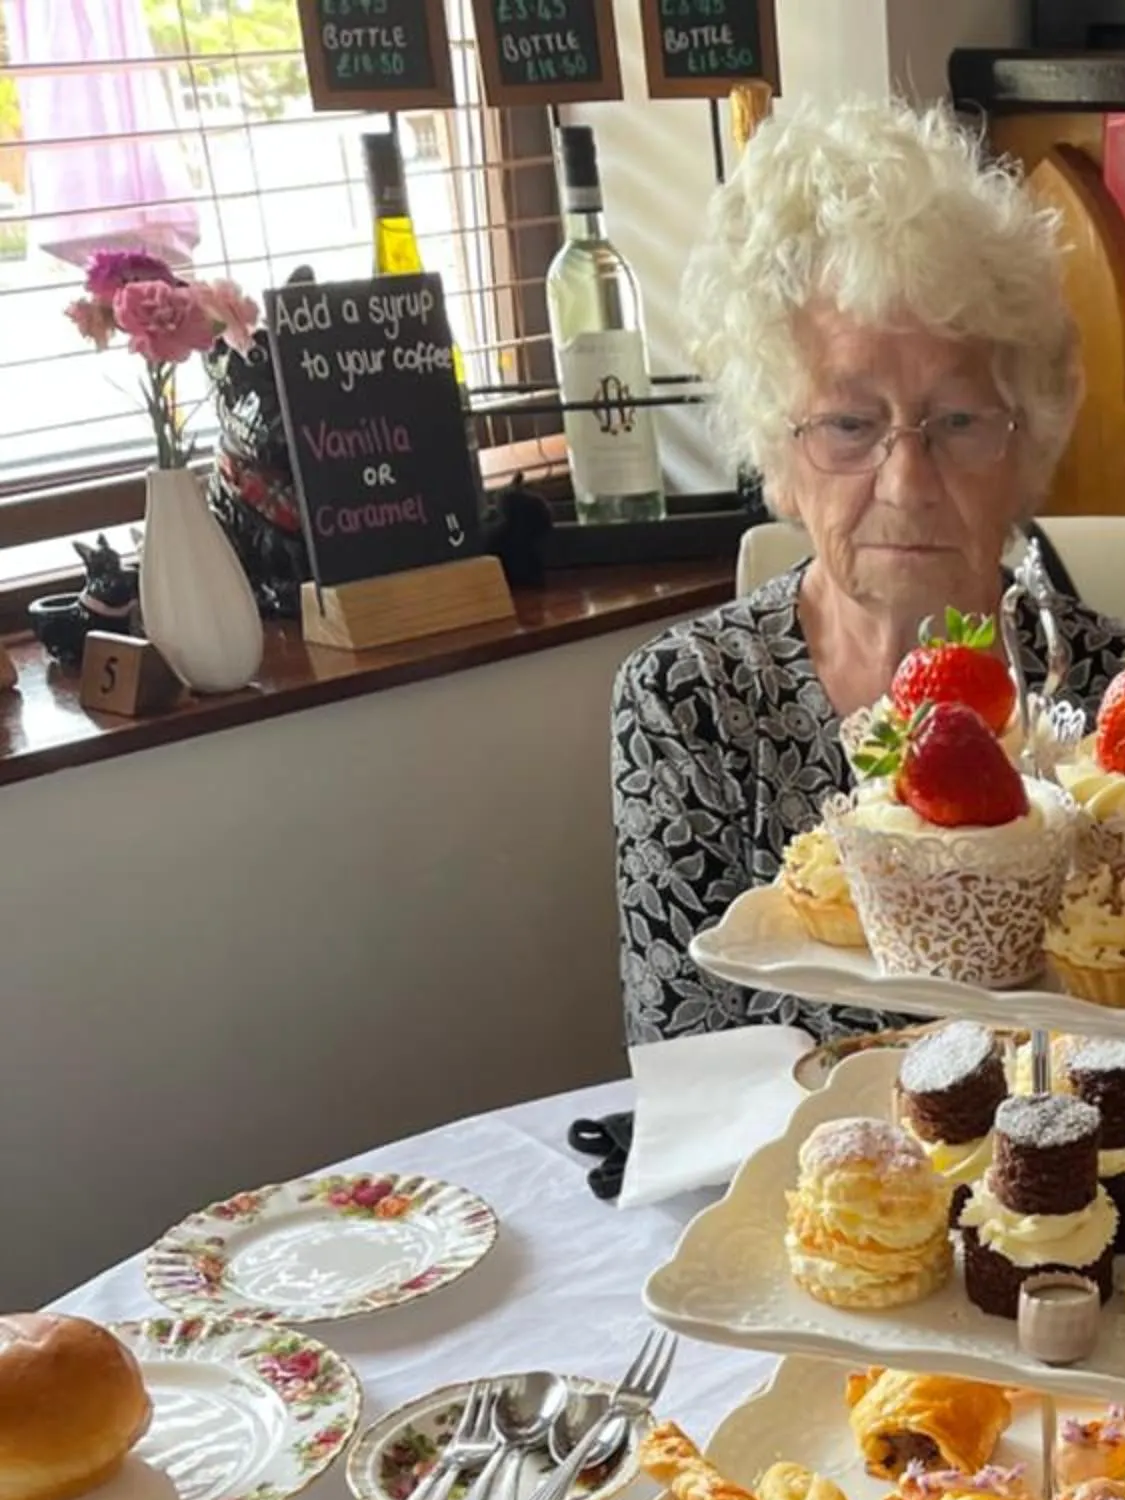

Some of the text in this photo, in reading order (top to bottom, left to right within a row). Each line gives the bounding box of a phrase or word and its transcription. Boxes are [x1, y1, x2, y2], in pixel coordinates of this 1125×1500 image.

[322, 22, 408, 50] BOTTLE
[502, 30, 579, 63] BOTTLE
[664, 23, 735, 54] BOTTLE
[275, 288, 434, 340] Add a syrup
[301, 341, 452, 392] to your coffee
[301, 416, 413, 461] Vanilla
[363, 463, 396, 487] OR
[315, 495, 428, 537] Caramel
[100, 655, 119, 696] 5
